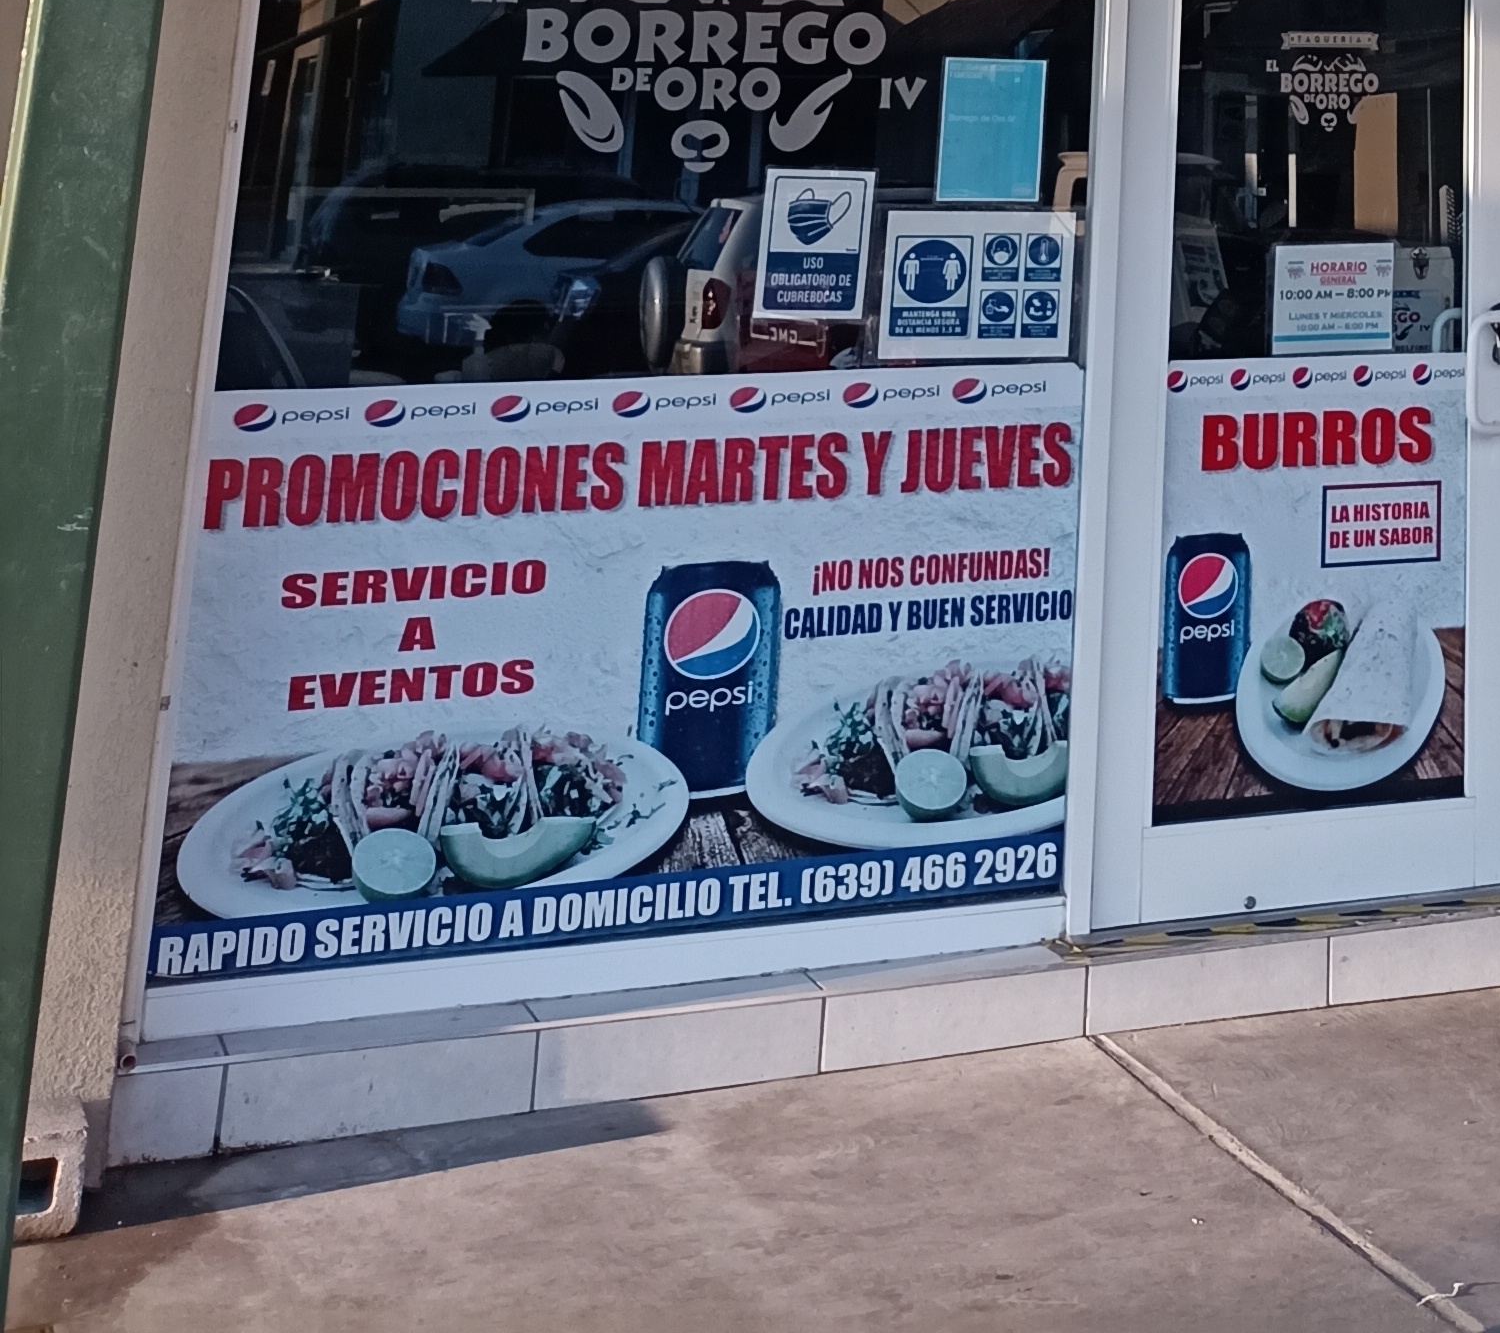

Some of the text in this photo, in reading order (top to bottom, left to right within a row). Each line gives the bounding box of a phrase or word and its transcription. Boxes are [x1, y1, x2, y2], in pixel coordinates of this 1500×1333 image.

[522, 7, 887, 66] BORREGO
[1297, 35, 1362, 44] TAQUERIA
[1266, 59, 1280, 73] EL
[611, 66, 781, 112] DE ORO
[879, 76, 928, 110] IV
[1280, 72, 1380, 93] BORREGO
[1303, 93, 1351, 110] DE ORO
[803, 256, 824, 269] USO
[1310, 261, 1368, 274] HORARIO
[770, 273, 853, 287] OBLIGATORIO DE
[1320, 275, 1357, 285] GENERAL
[776, 289, 843, 304] CUBREBOCAS
[1280, 290, 1313, 300] 10:00
[1315, 290, 1333, 300] AM
[1347, 288, 1375, 299] 8:00
[1288, 312, 1320, 321] LUNES
[1190, 367, 1465, 387] pepsi pepsi pepsi pepsi pepsi
[281, 380, 1048, 425] pepsi pepsi pepsi pepsi pepsi pepsi pepsi
[1202, 406, 1434, 472] BURROS
[203, 422, 1074, 531] PROMOCIONES MARTES Y JUEVES
[1331, 501, 1430, 523] LA HISTORIA
[1329, 526, 1433, 549] DE UN SABOR
[812, 547, 1051, 596] ¡NO NOS CONFUNDAS!
[281, 559, 548, 610] SERVICIO
[784, 590, 1073, 640] CALIDAD Y BUEN SERVICIO
[397, 616, 437, 653] A
[1180, 620, 1235, 644] pepsi
[287, 659, 536, 712] EVENTOS
[665, 680, 755, 716] pepsi
[157, 842, 1058, 976] RAPIDO SERVICIO A DOMICILIO TEL. (639) 466 2926
